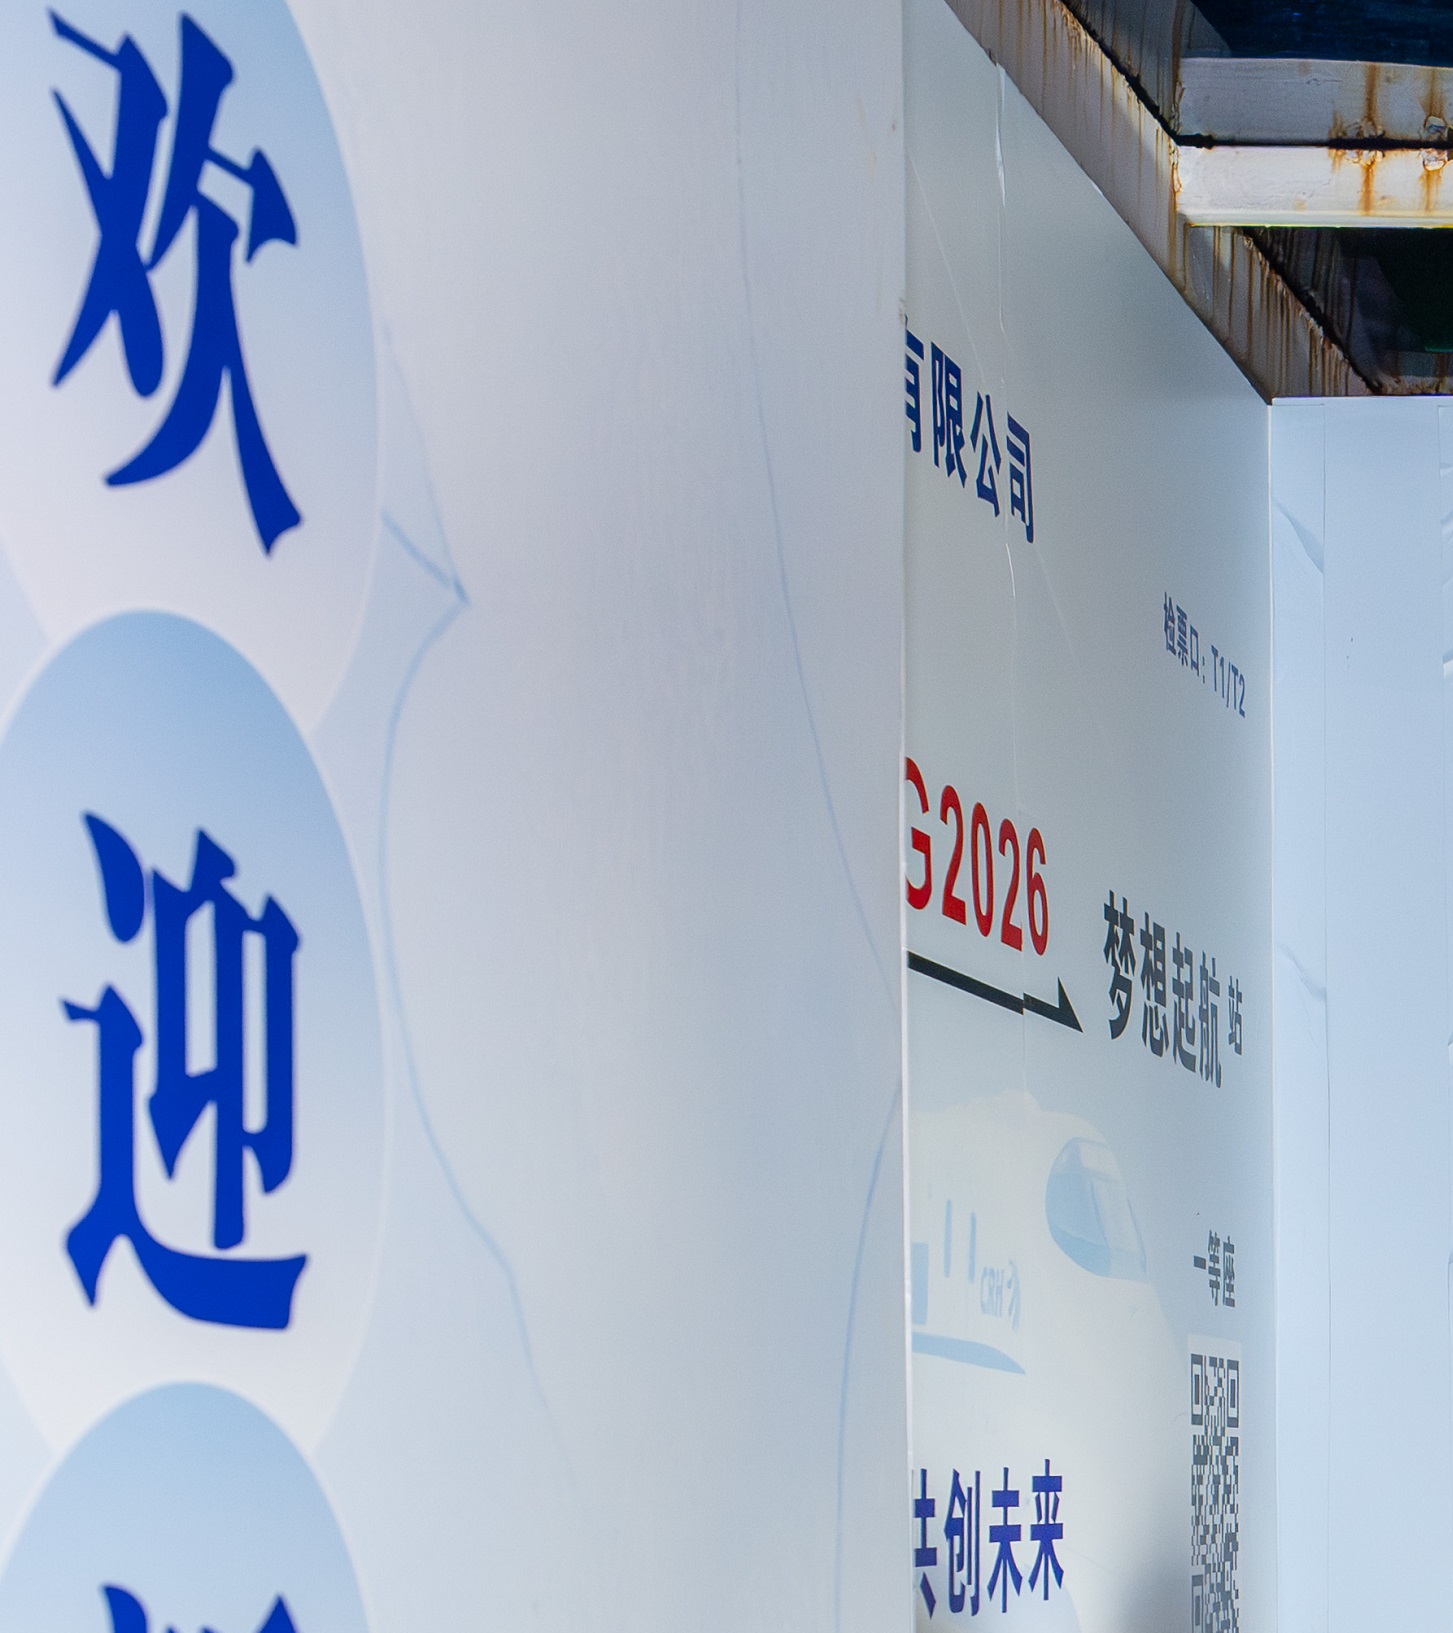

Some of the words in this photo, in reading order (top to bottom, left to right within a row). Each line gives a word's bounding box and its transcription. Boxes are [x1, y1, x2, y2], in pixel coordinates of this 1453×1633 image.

[905, 757, 1049, 956] G2026
[1193, 1229, 1235, 1307] 一等座
[914, 1459, 1064, 1620] 共创未来
